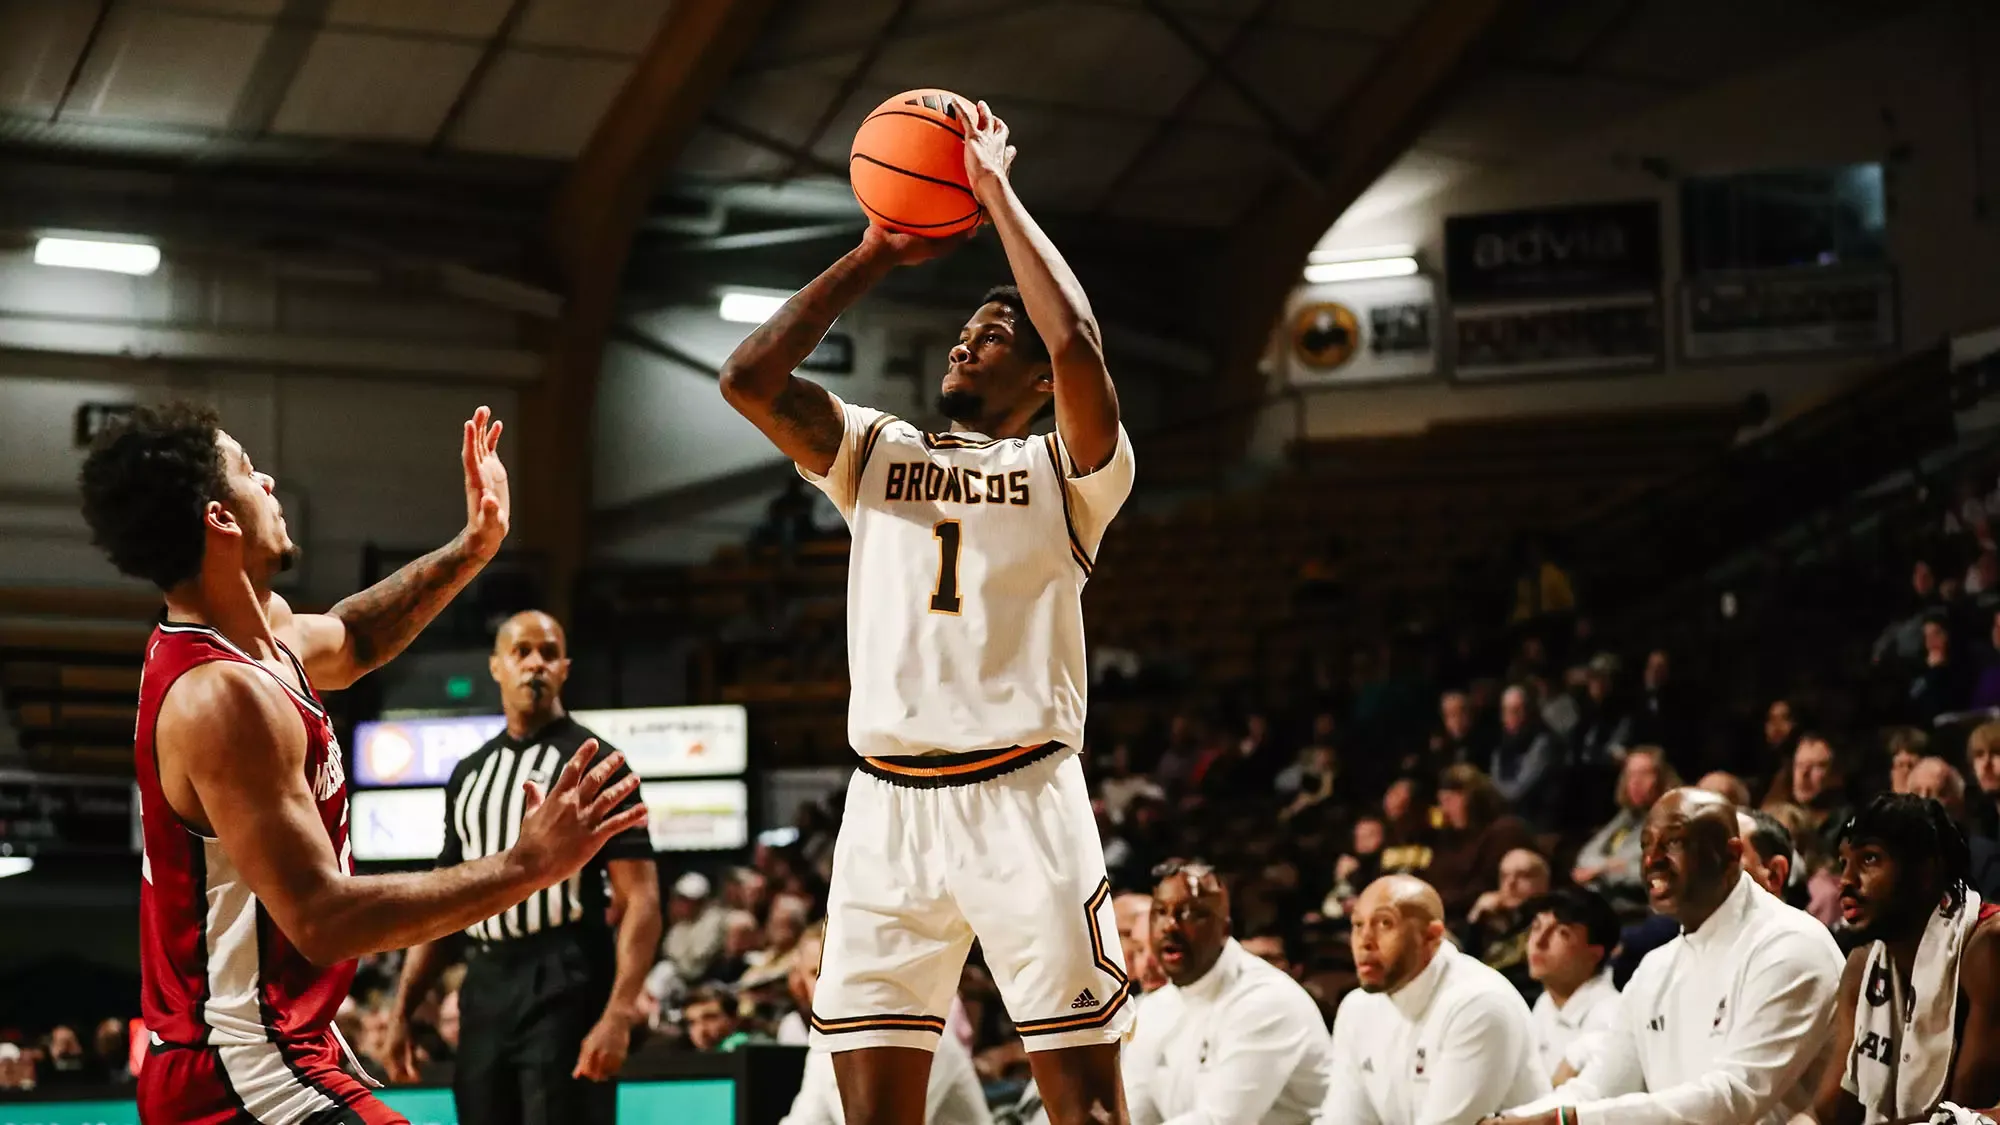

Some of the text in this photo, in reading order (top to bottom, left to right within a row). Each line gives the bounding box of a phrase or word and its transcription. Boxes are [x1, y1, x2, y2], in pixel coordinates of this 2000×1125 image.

[1473, 220, 1625, 270] advia
[885, 461, 1030, 506] BRONCOS
[928, 518, 964, 617] 1
